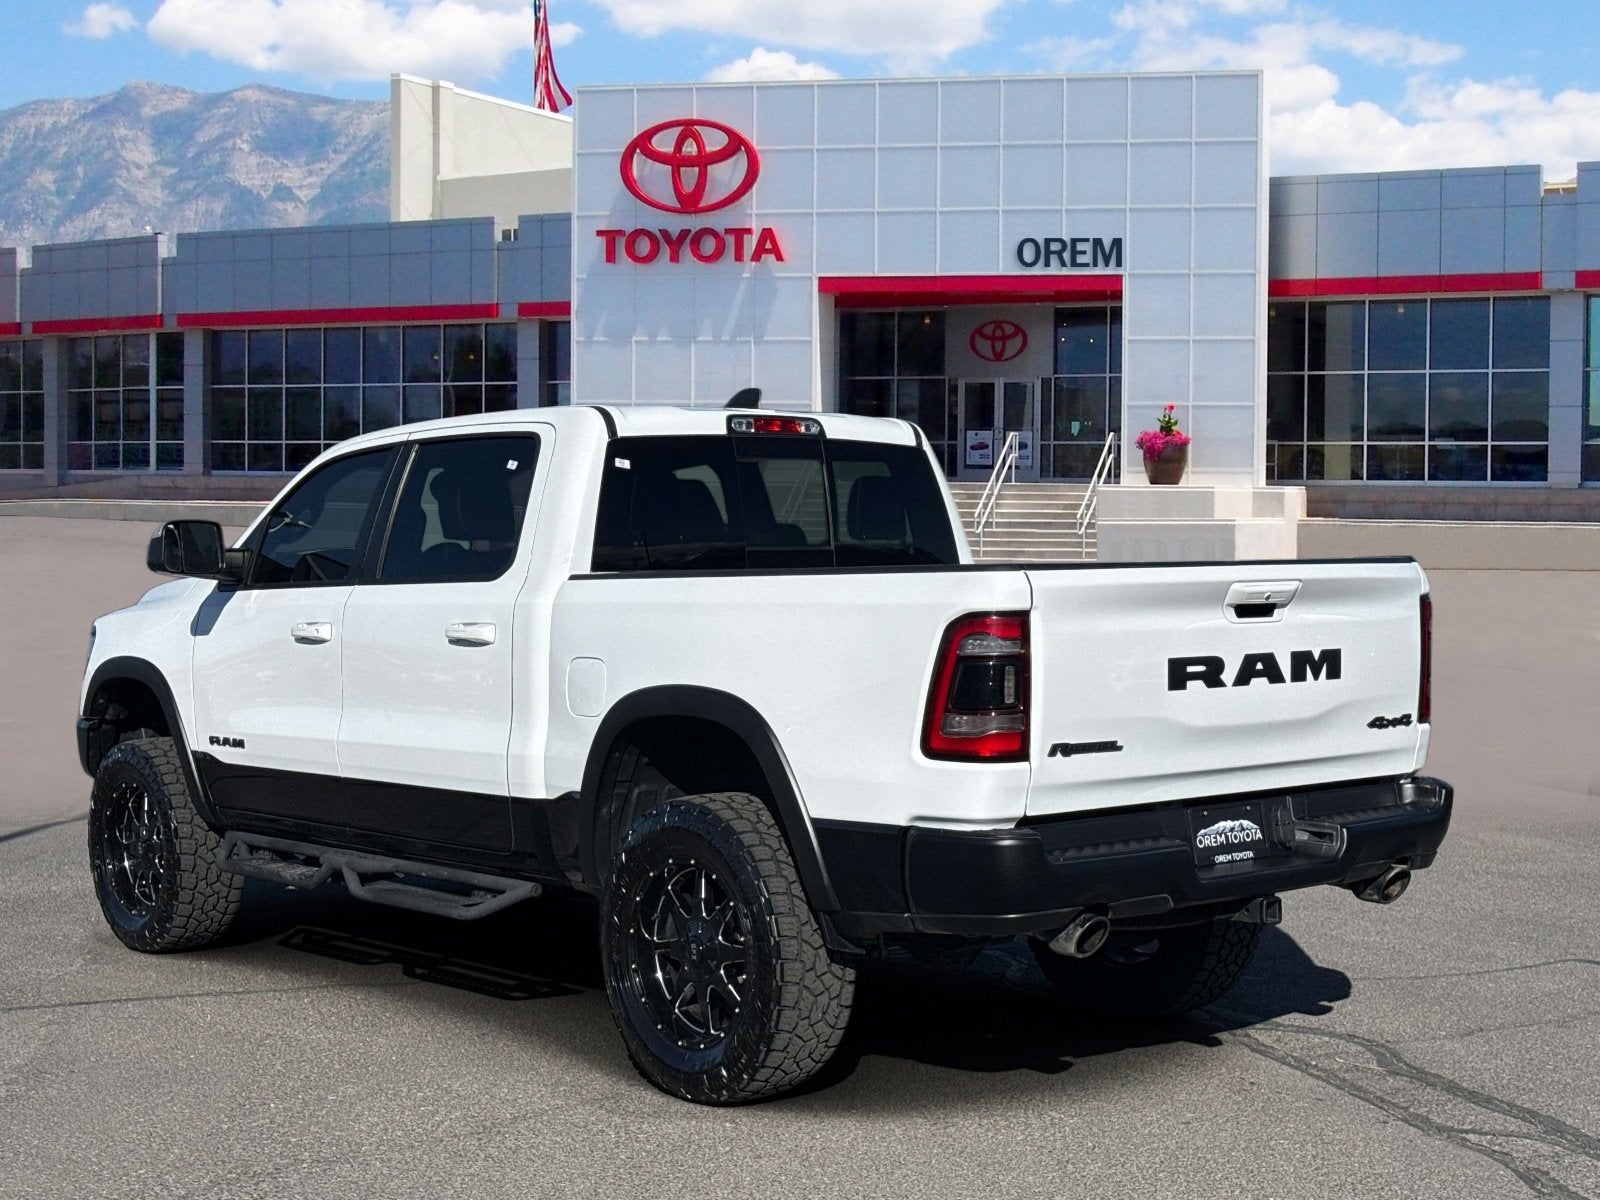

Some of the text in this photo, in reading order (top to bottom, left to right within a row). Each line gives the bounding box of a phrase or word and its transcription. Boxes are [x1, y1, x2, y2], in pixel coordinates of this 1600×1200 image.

[596, 227, 785, 264] TOYOTA
[1016, 237, 1123, 268] OREM
[1167, 648, 1342, 692] RAM
[1366, 713, 1413, 730] 4x4
[208, 735, 246, 750] RAM
[1196, 828, 1263, 848] OREM TOYOTA
[1214, 850, 1255, 863] OREM TOYOTA
